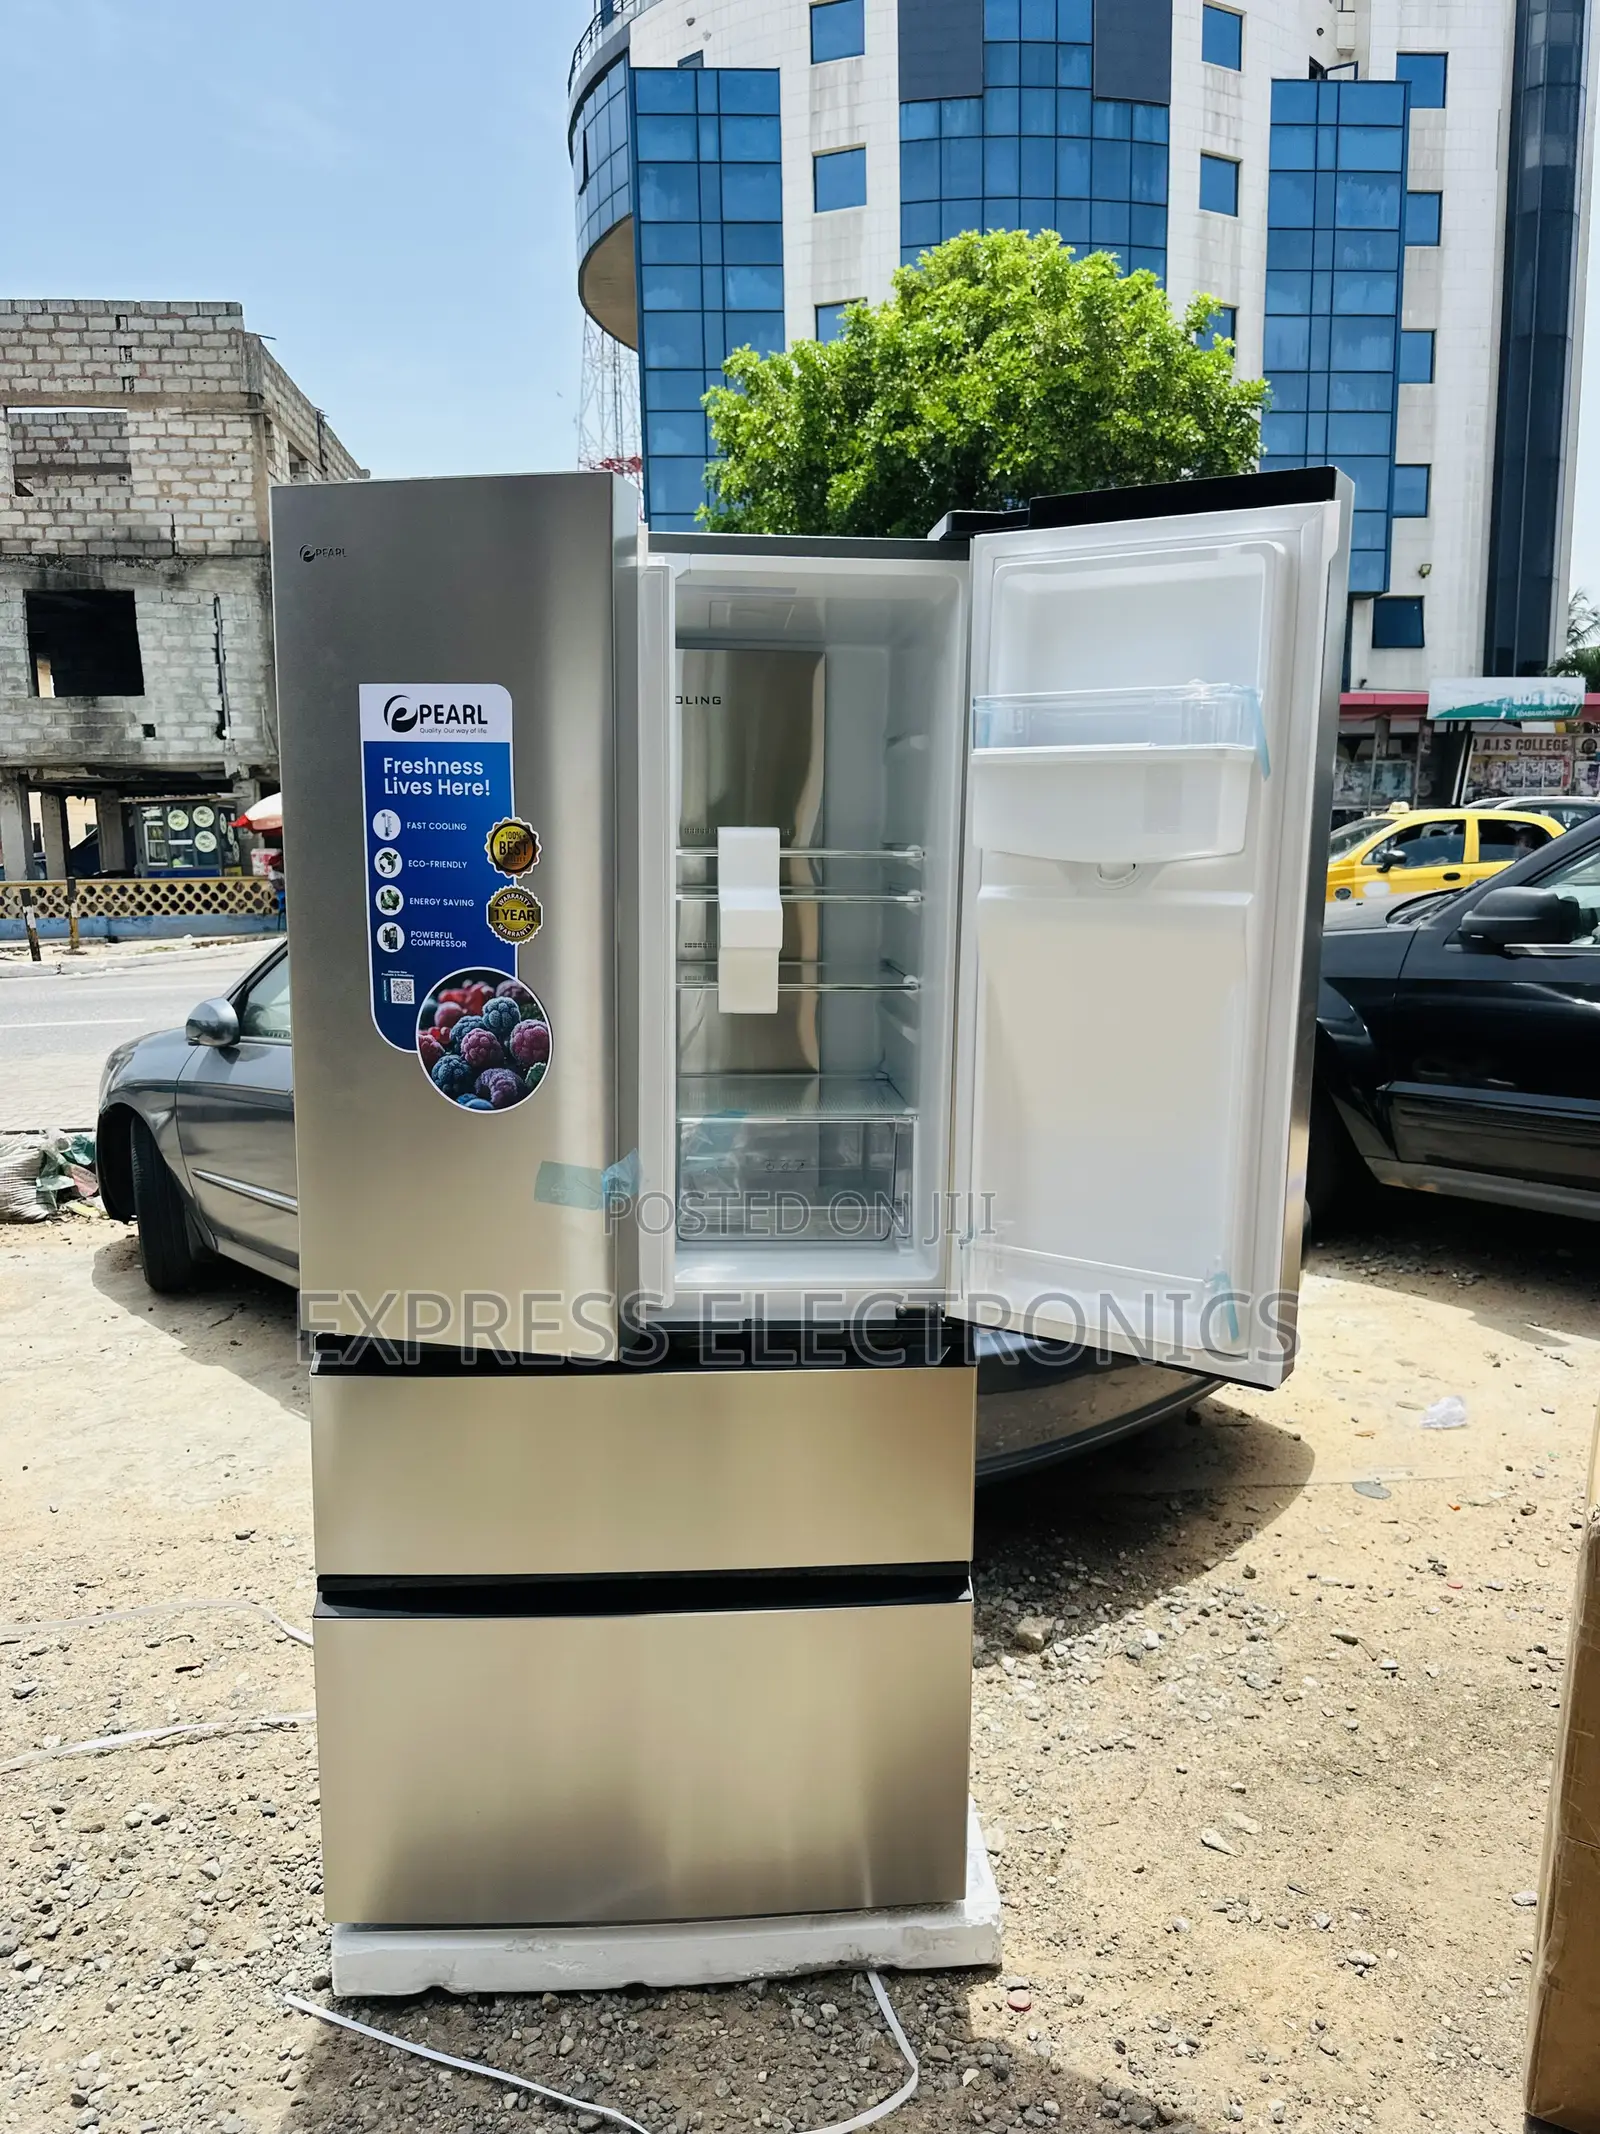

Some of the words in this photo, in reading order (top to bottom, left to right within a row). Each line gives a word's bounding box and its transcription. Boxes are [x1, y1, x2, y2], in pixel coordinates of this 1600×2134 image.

[419, 703, 488, 725] PEARL
[456, 728, 469, 736] way
[1515, 738, 1569, 752] COLLEGE
[383, 757, 484, 775] Freshness
[384, 776, 433, 795] Lives
[438, 778, 490, 797] Here!
[406, 821, 427, 830] FAST
[428, 822, 468, 831] COOLING
[505, 831, 522, 840] 100%
[499, 840, 529, 856] BEST
[408, 859, 467, 869] ECO-FRIENDLY
[409, 897, 441, 906] ENERGY
[443, 898, 475, 907] SAVING
[498, 892, 531, 906] WARRANTY
[502, 908, 535, 921] YEAR
[410, 930, 454, 940] POWERFUL
[498, 923, 532, 937] WARRANTY
[410, 938, 467, 948] COMPRESSOR
